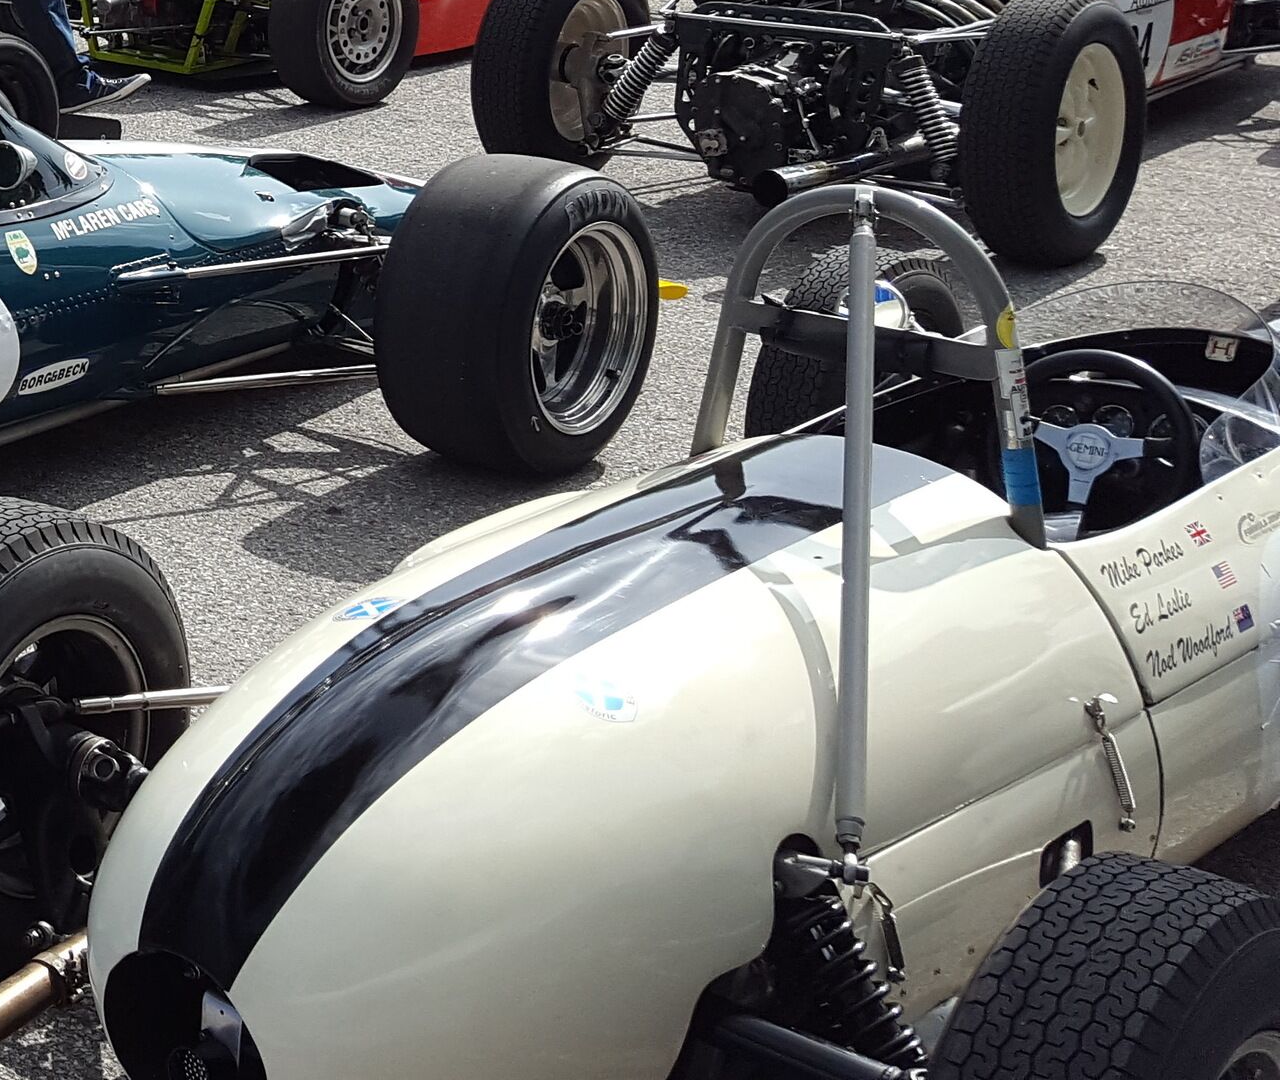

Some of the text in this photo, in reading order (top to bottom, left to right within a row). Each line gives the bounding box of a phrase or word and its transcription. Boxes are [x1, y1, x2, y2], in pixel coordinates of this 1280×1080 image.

[117, 197, 161, 222] CARS
[19, 361, 90, 392] BORG&BECK
[1070, 443, 1107, 457] GEMINI
[1101, 542, 1184, 589] Mike Parkes
[1129, 590, 1192, 634] Ed Leslie
[1146, 622, 1234, 678] Noel Woodford
